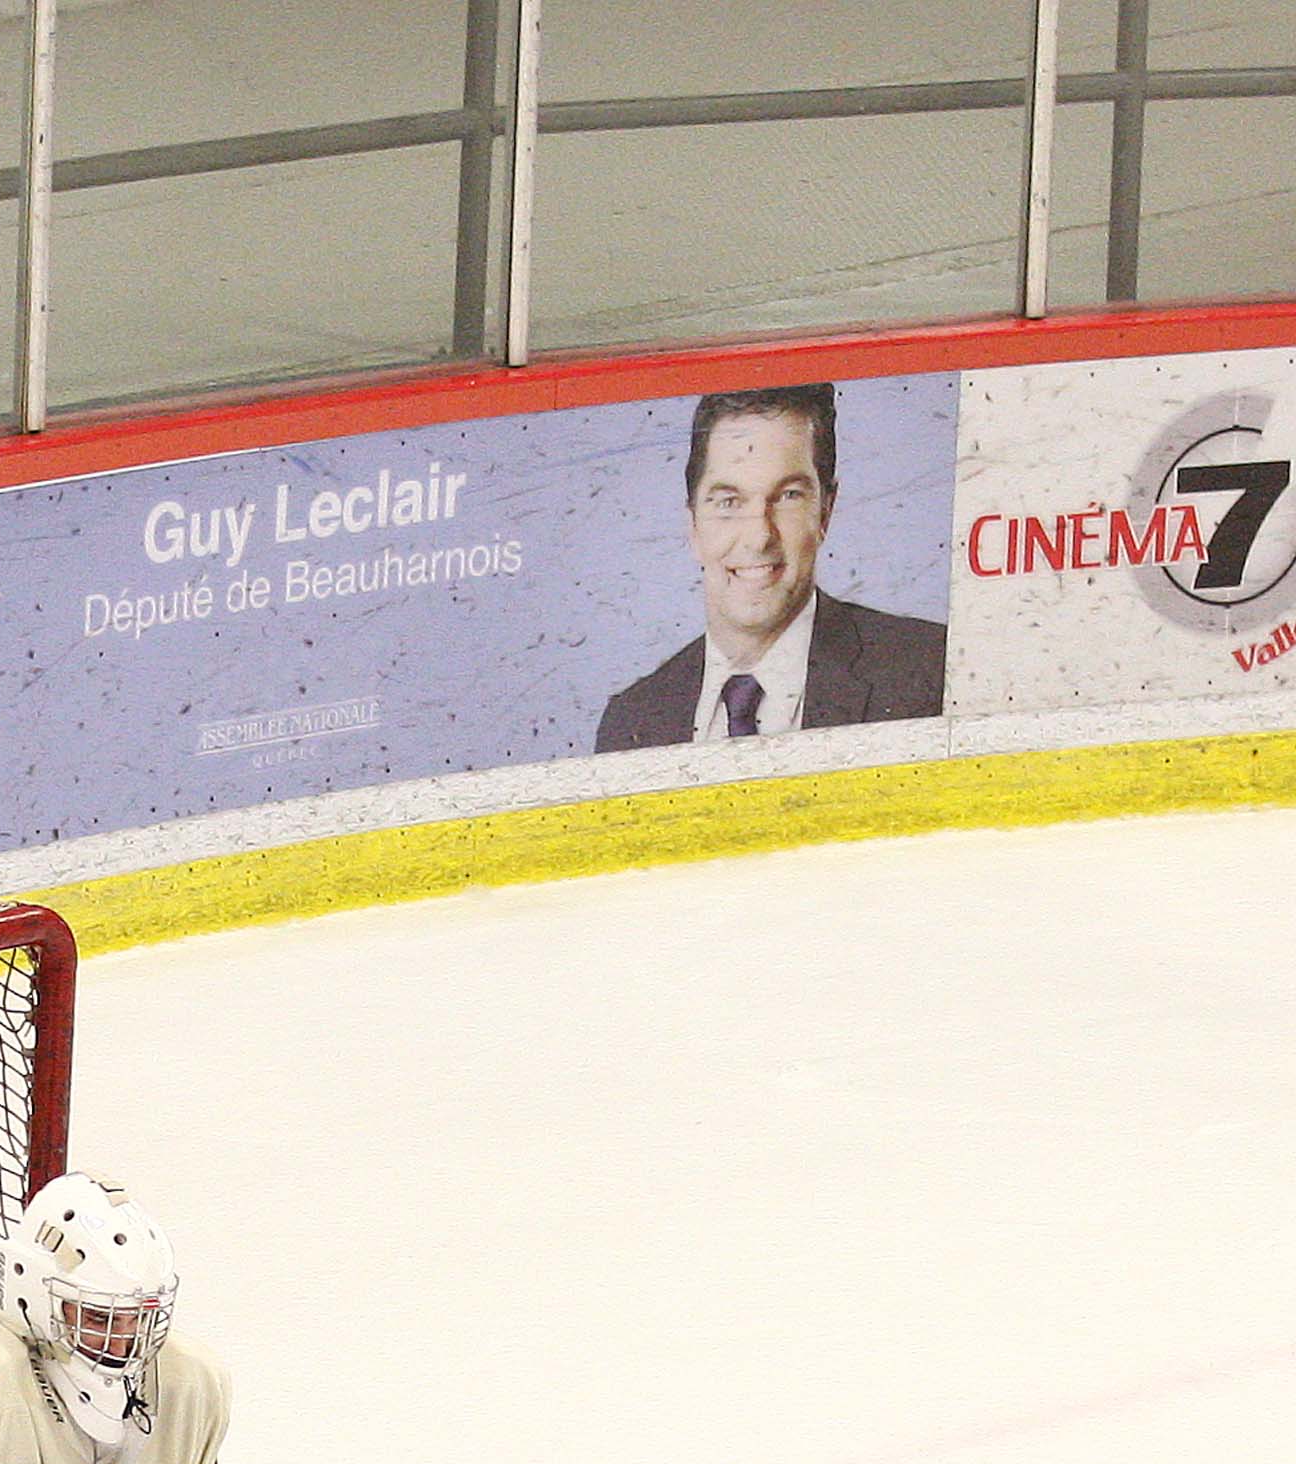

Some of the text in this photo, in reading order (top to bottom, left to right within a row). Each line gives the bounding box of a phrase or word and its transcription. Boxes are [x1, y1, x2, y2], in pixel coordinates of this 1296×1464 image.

[144, 463, 468, 567] Guy Leclair
[967, 460, 1291, 589] CINÉMA 7
[84, 533, 523, 639] Député de Beauharnois
